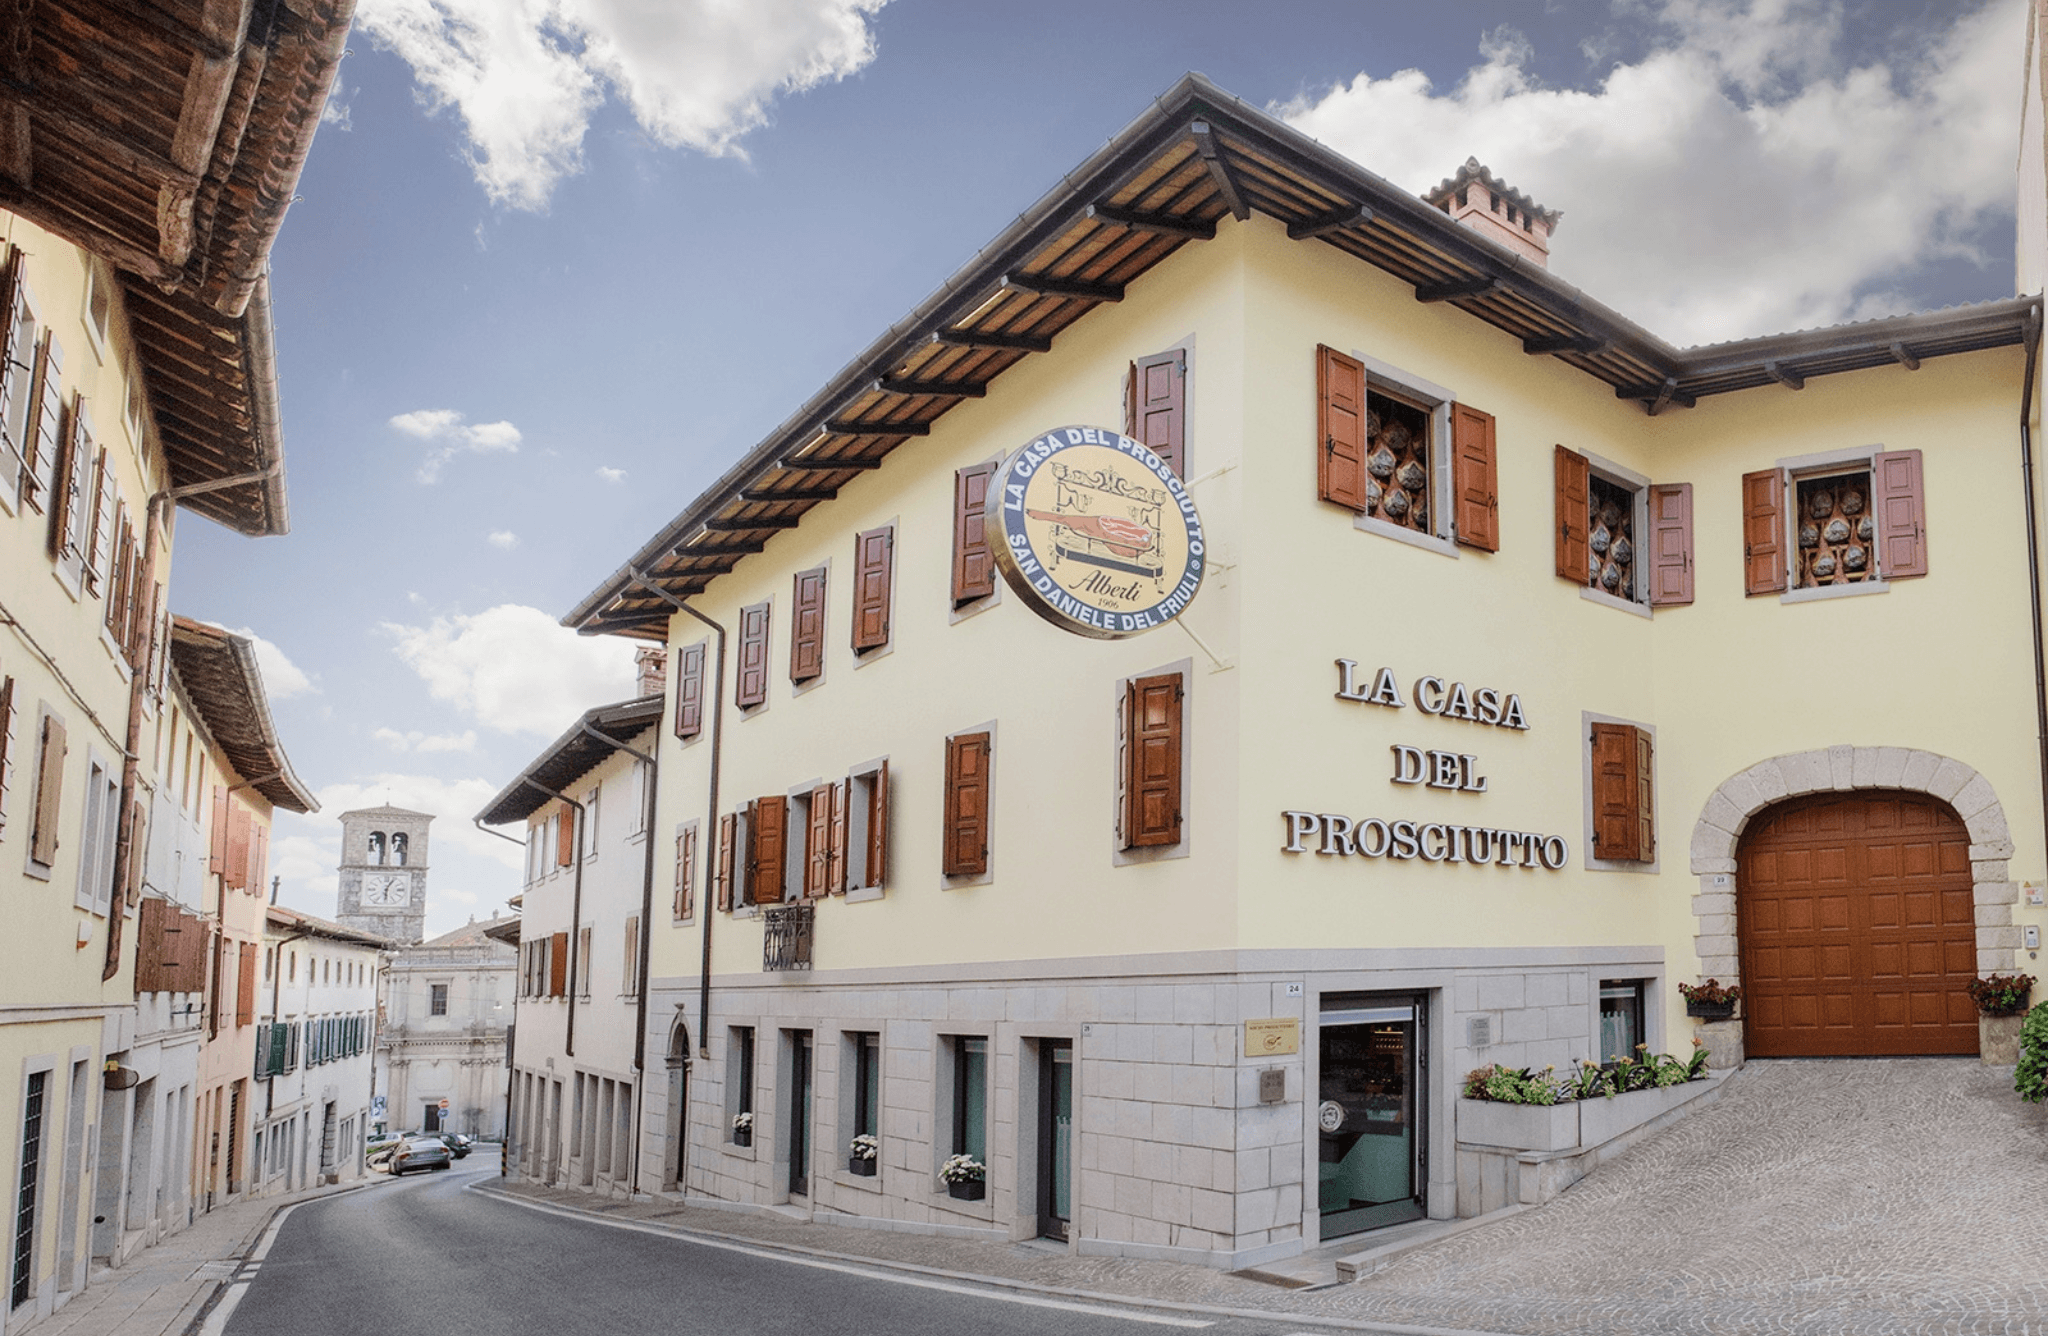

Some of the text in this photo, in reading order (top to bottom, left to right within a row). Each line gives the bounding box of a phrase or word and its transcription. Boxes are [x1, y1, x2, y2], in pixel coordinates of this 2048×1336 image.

[1004, 428, 1204, 555] LA CASA DEL PROSCIUTTO
[1009, 533, 1200, 631] SAN DANIELE DEL FRIULI
[1068, 569, 1143, 602] Alberti
[1334, 658, 1531, 731] LA CASA
[1390, 744, 1488, 793] DEL
[1281, 810, 1570, 870] PROSCIUTTO
